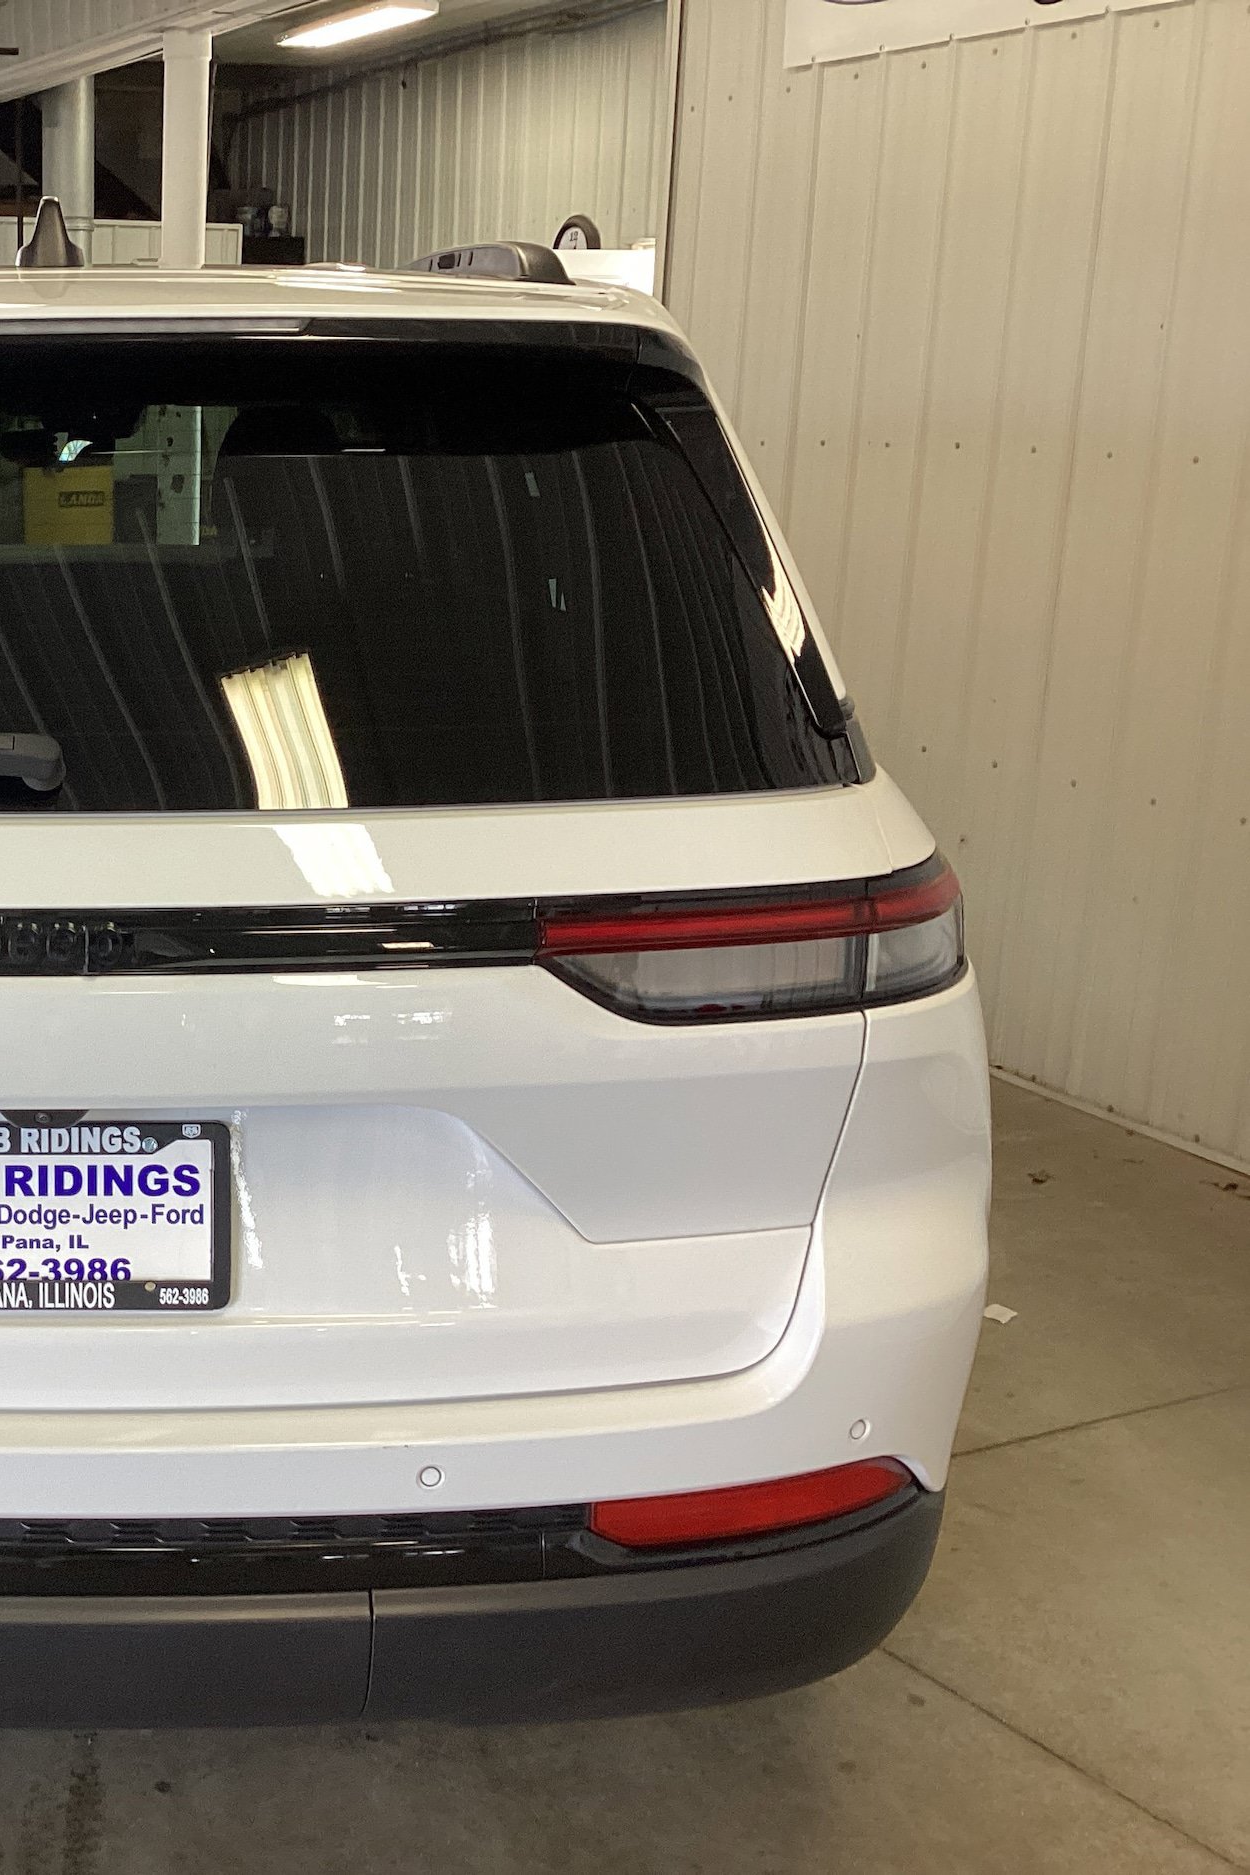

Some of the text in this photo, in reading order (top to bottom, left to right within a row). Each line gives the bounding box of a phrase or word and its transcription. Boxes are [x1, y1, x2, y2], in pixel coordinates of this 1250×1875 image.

[570, 231, 579, 241] 12
[21, 1127, 141, 1154] RIDINGS
[4, 1164, 201, 1198] RIDINGS
[1, 1235, 89, 1252] Pana, IL
[39, 1282, 115, 1309] ILLINOIS
[159, 1287, 209, 1305] 562-3986
